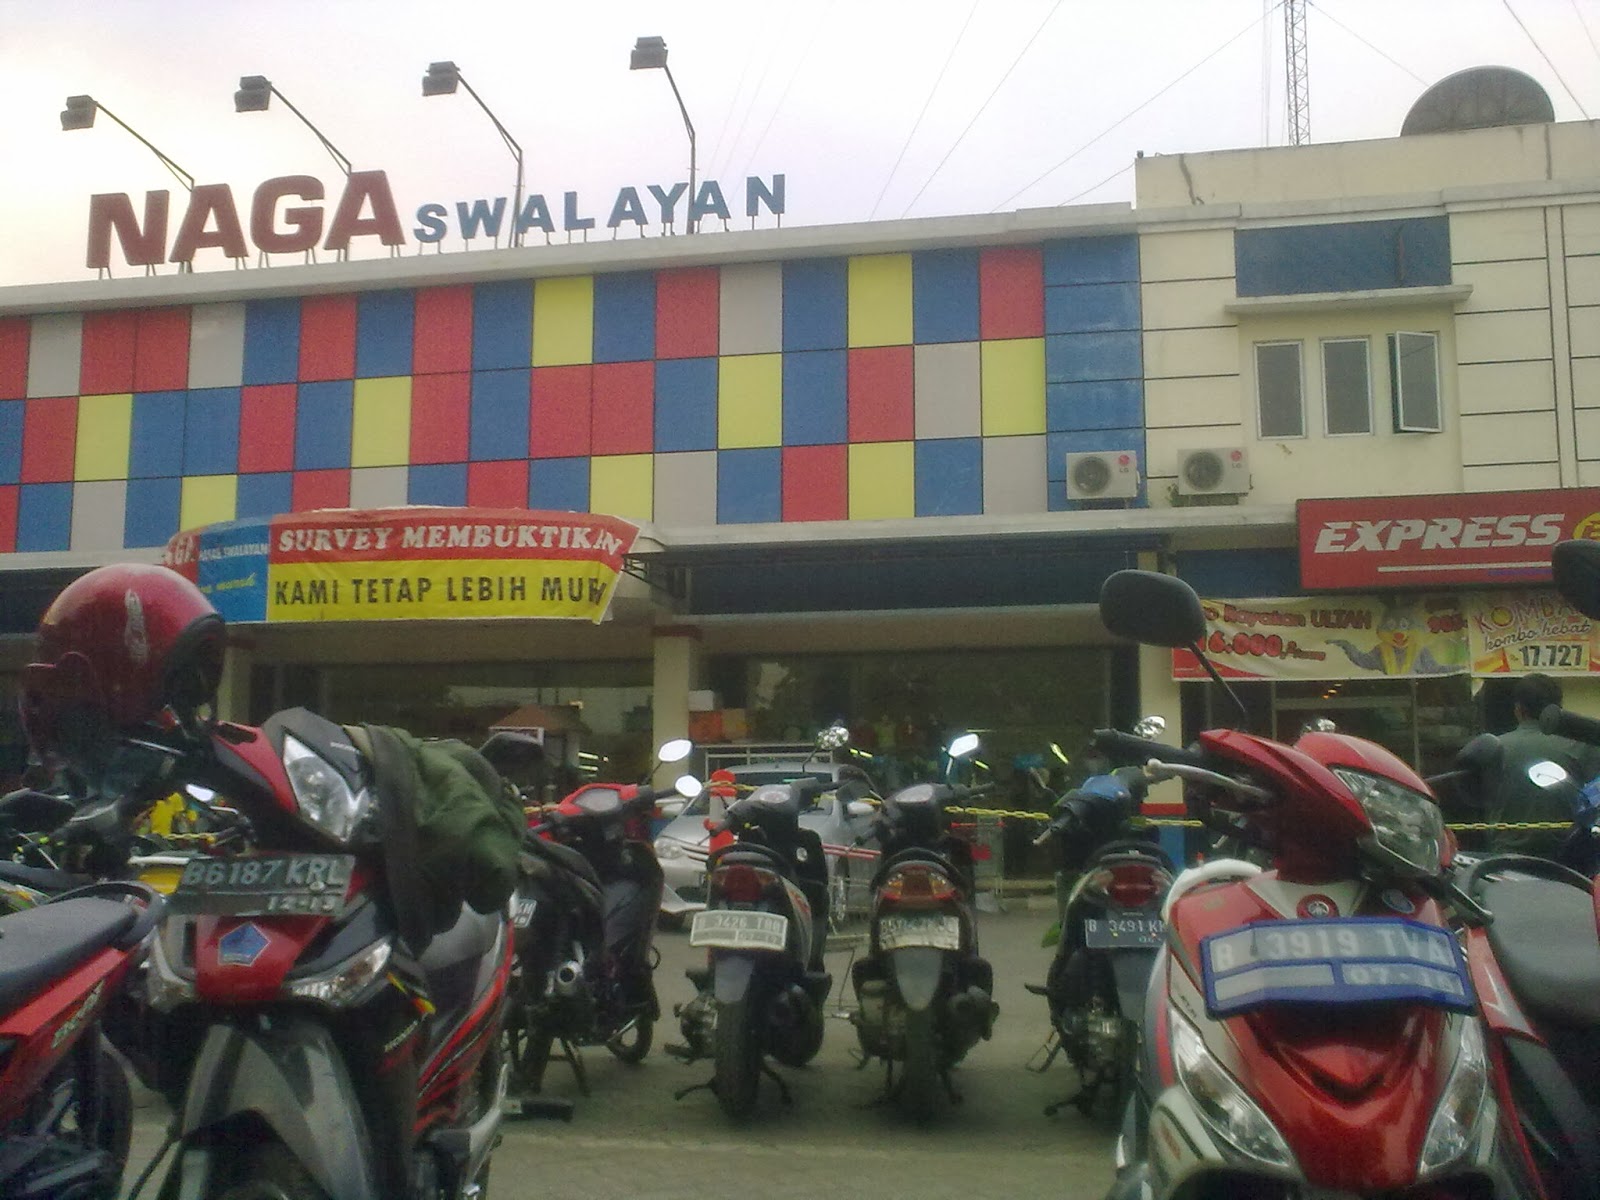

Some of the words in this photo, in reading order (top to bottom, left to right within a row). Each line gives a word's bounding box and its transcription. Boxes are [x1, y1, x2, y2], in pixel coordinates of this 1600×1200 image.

[86, 169, 406, 269] NAGA
[413, 174, 785, 244] SWALAYAN
[279, 527, 394, 552] SURVEY
[401, 524, 623, 556] MEMBUKTIKAN
[1314, 513, 1565, 553] EXPRESS
[275, 579, 339, 605] KAMI
[352, 577, 432, 604] TETAP
[447, 576, 526, 602] LEBIH
[1310, 608, 1373, 630] ULTAH
[1484, 627, 1537, 652] kombo
[1542, 618, 1592, 637] hebat
[1518, 644, 1583, 667] 17.727
[1088, 920, 1097, 932] B
[1108, 920, 1143, 933] 3491
[1266, 931, 1360, 959] 3919
[1376, 929, 1446, 963] TVA
